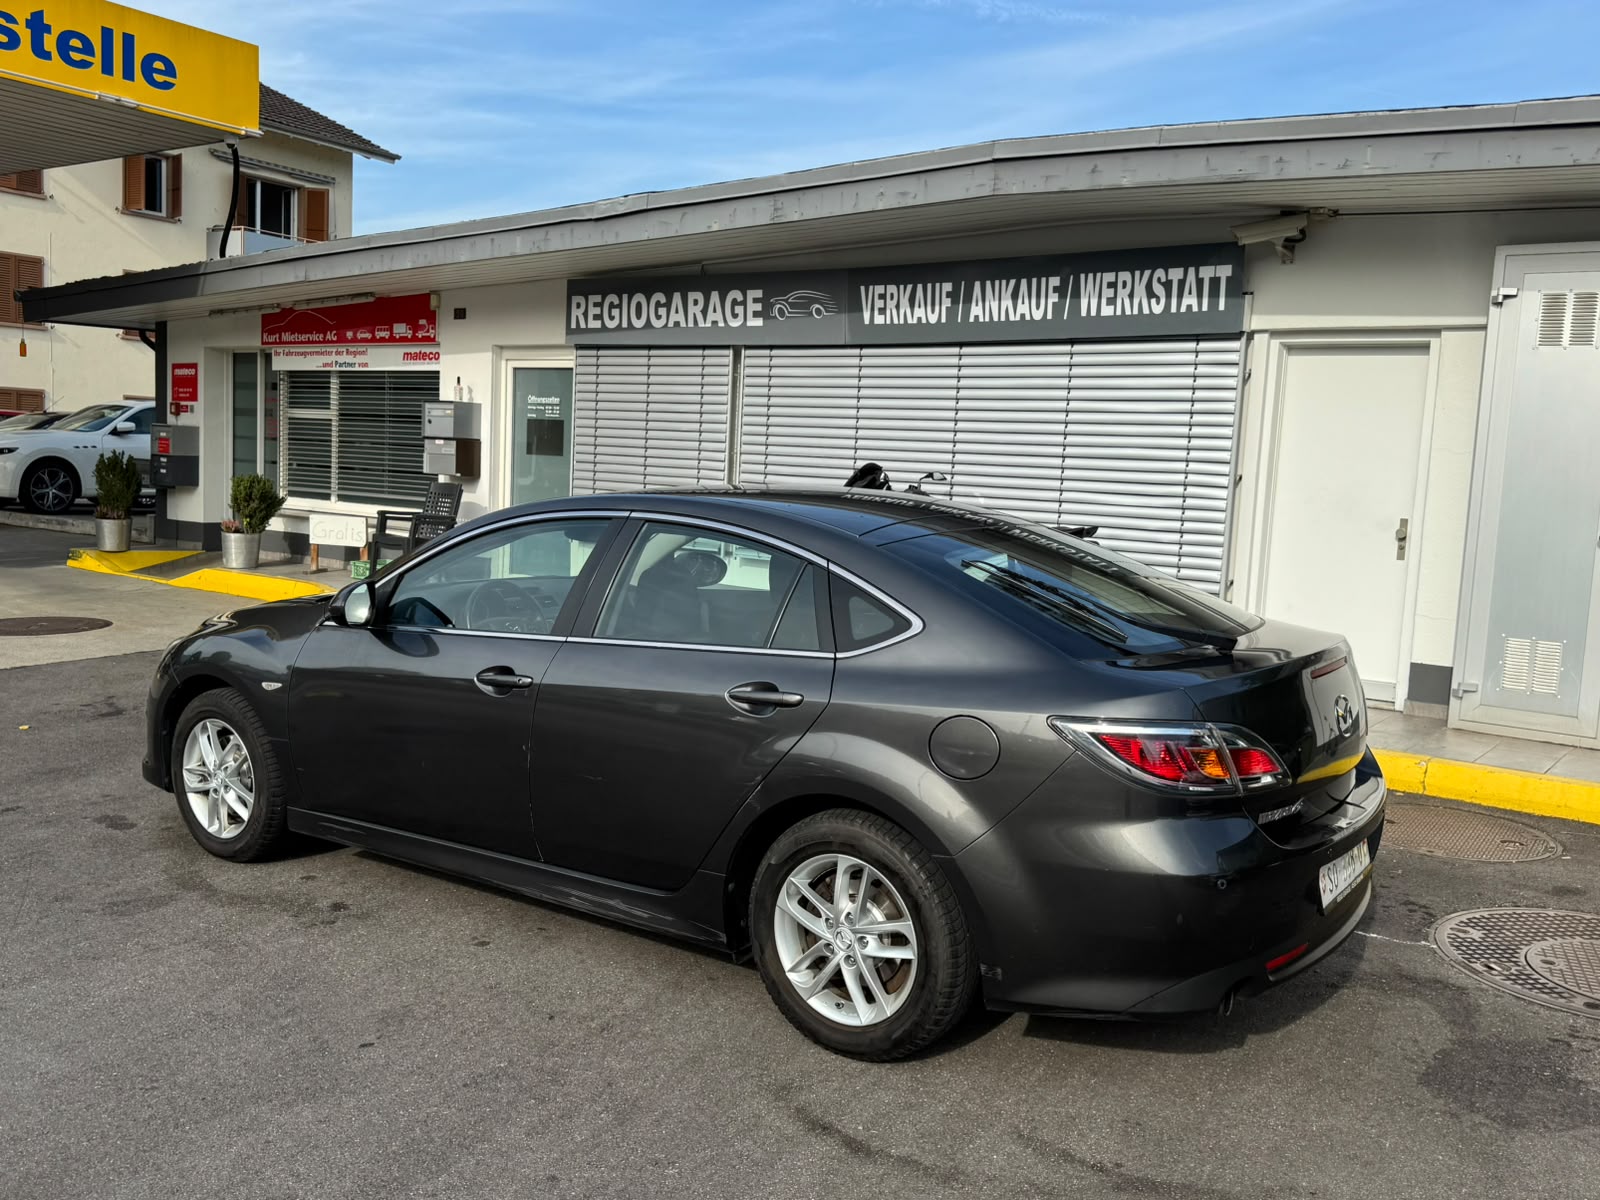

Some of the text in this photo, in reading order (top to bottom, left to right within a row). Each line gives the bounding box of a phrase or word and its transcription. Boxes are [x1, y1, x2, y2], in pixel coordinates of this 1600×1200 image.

[860, 282, 953, 325] VERKAUF
[969, 276, 1061, 323] ANKAUF
[1080, 264, 1233, 317] WERKSTATT
[570, 289, 764, 329] REGIOGARAGE
[263, 330, 338, 343] Kurt Mietservice AG
[273, 349, 282, 357] Ihr
[335, 347, 345, 357] der
[345, 347, 369, 358] Region!
[402, 349, 440, 362] mateco
[335, 360, 356, 369] Partner
